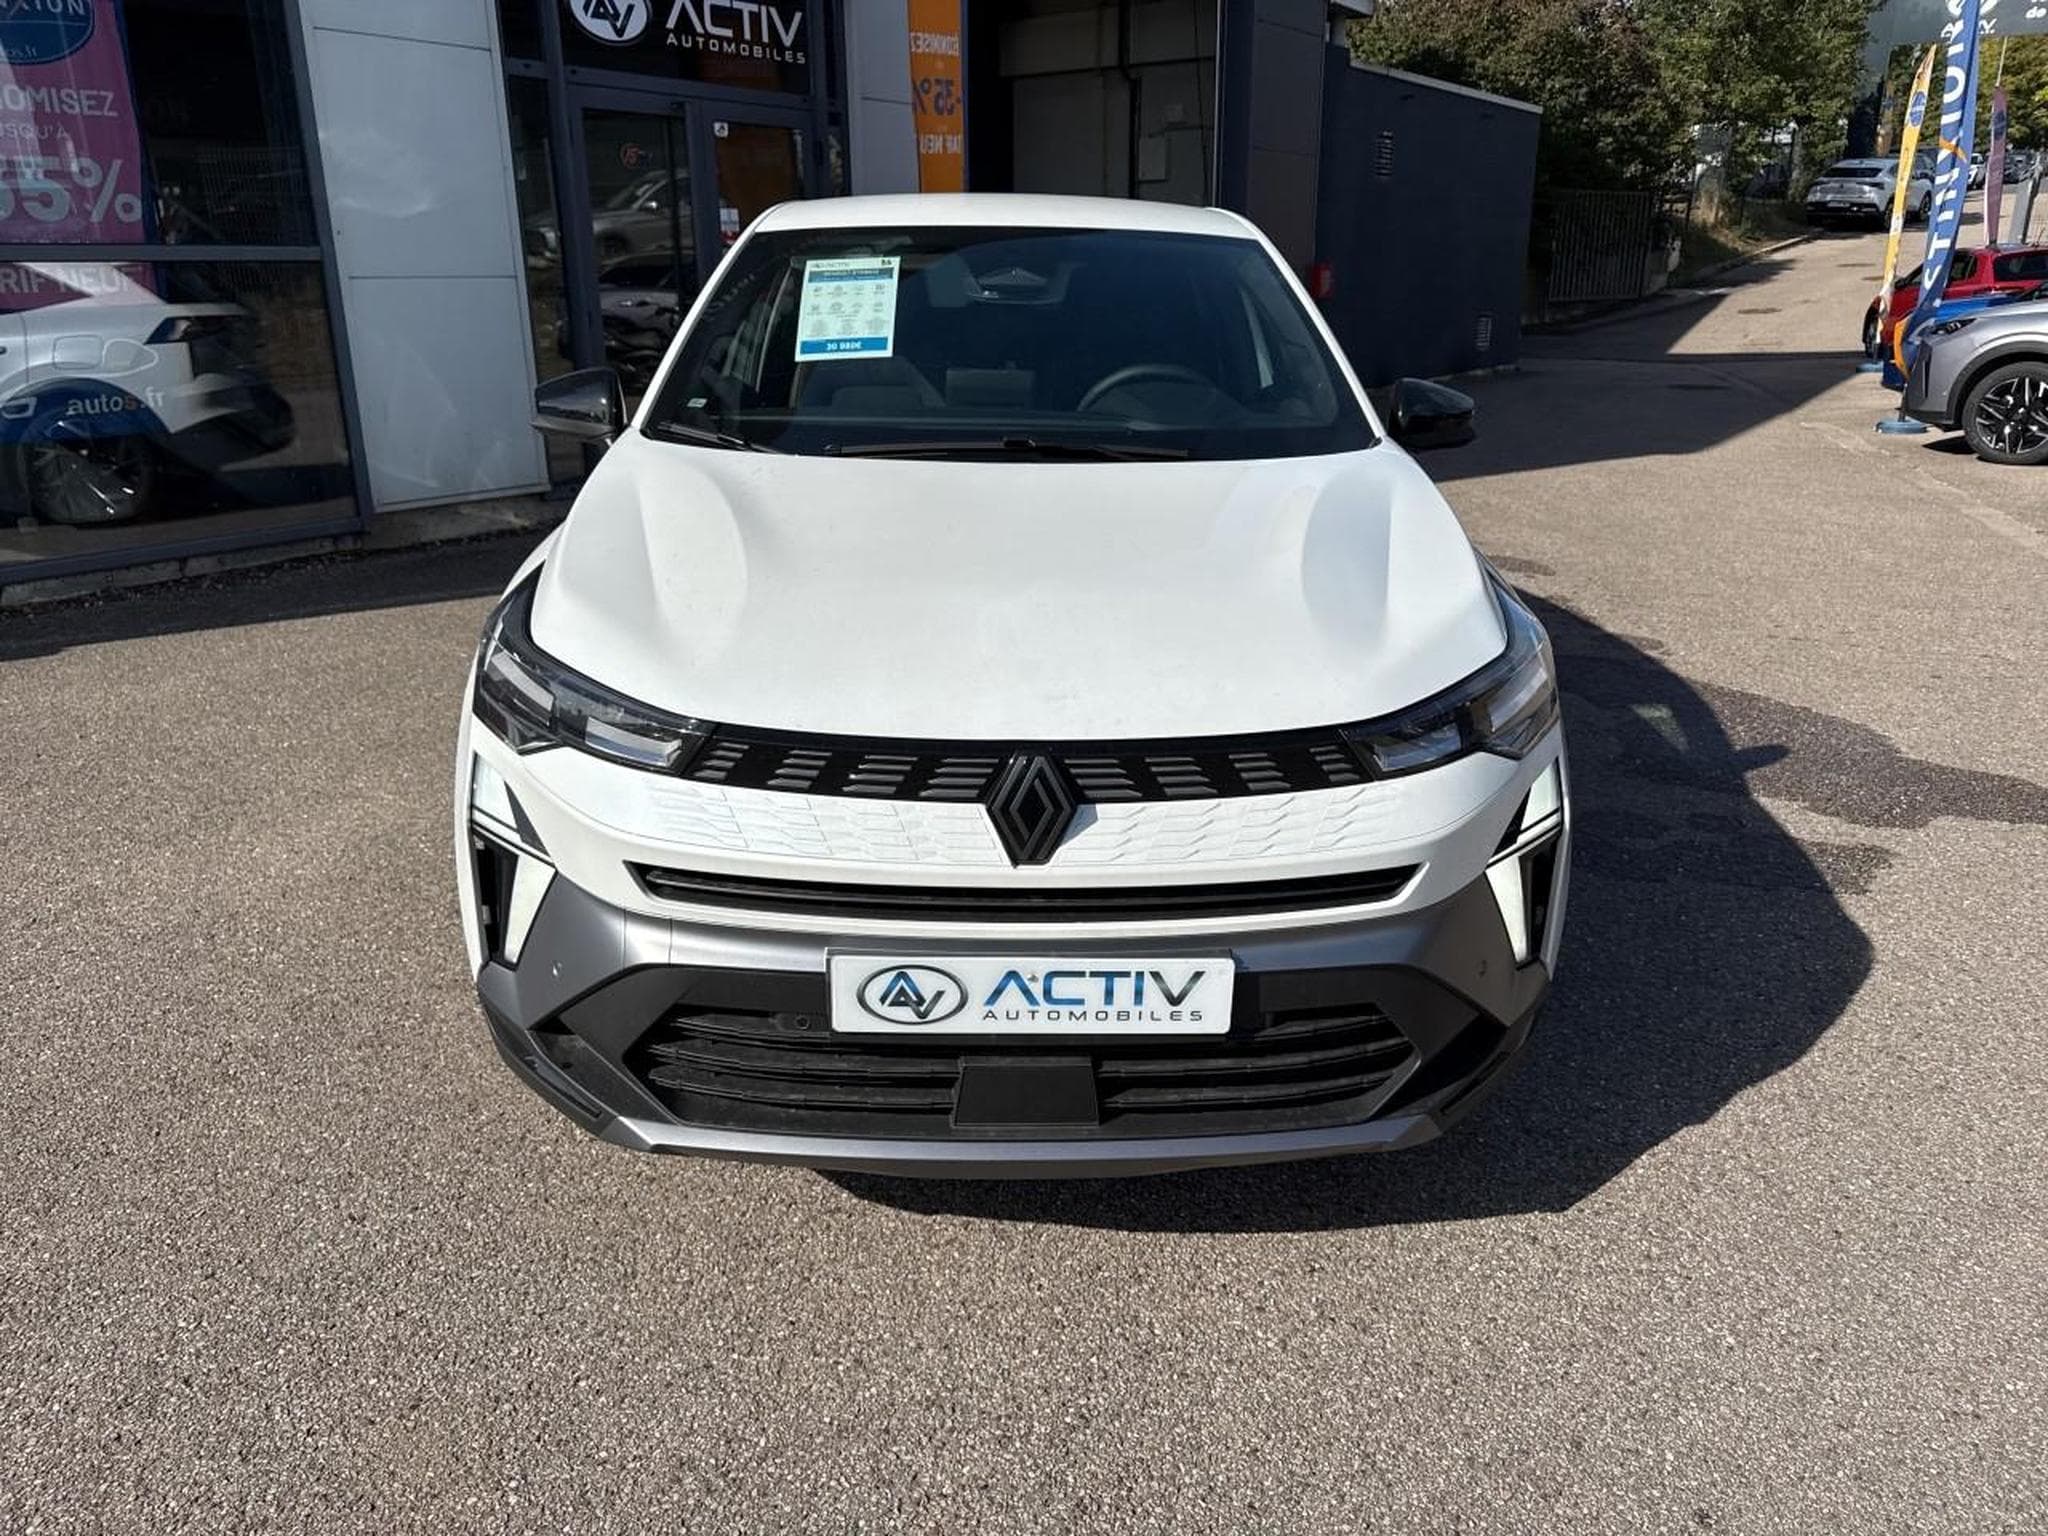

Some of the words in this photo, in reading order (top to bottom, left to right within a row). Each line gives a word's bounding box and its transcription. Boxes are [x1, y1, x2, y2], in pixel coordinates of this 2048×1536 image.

[665, 0, 802, 47] ACTIV
[666, 32, 806, 64] AUTOMOBILES
[0, 83, 119, 117] OMISEZ
[983, 969, 1206, 1007] ACTIV
[983, 1009, 1203, 1022] AUTOMOBILES
